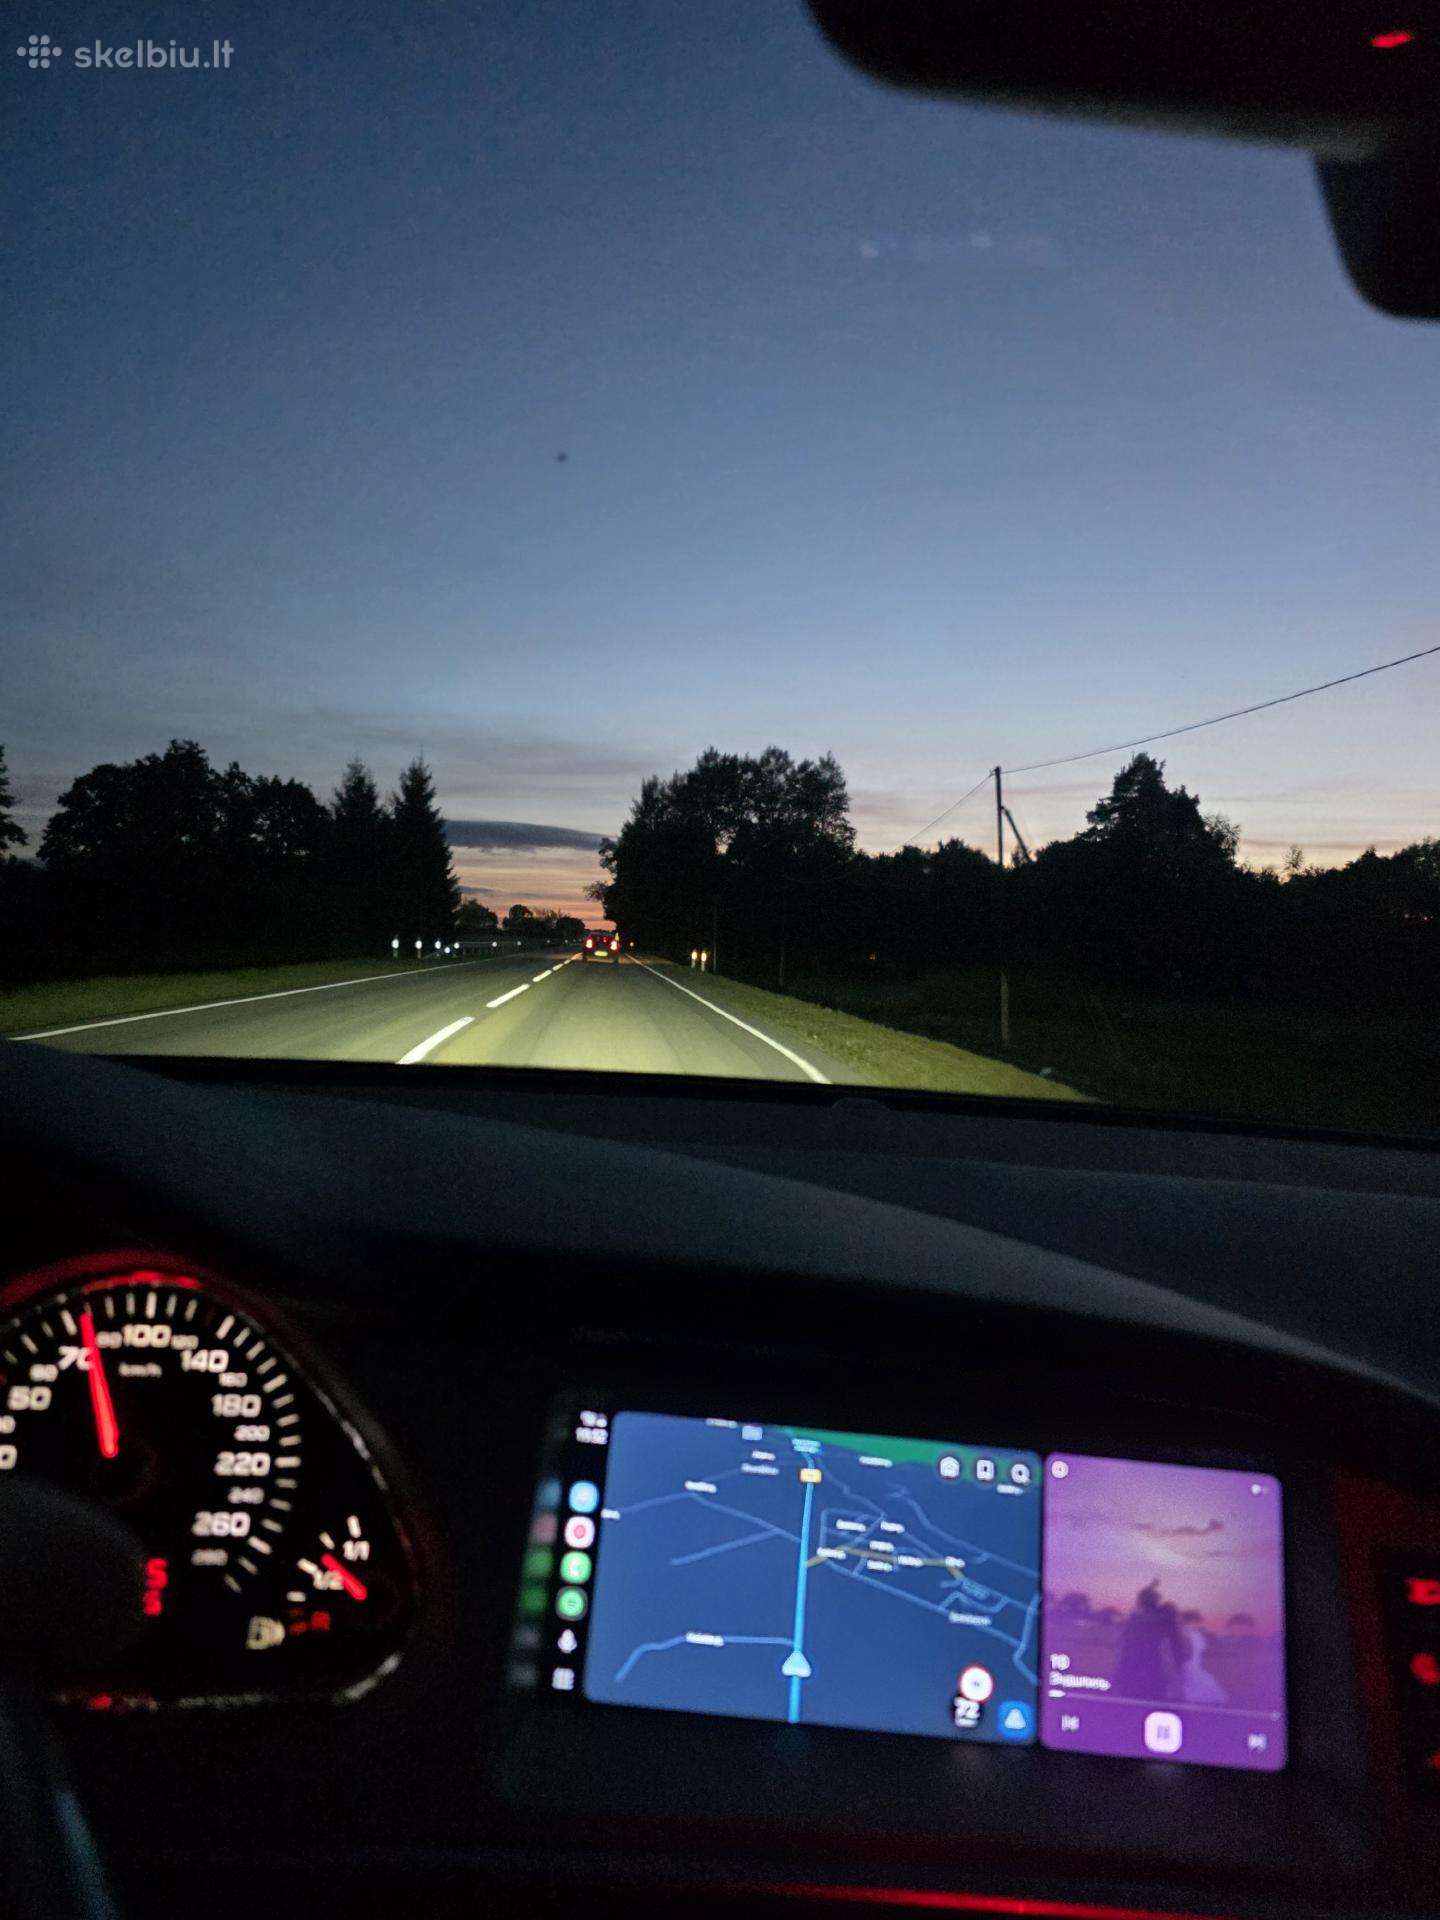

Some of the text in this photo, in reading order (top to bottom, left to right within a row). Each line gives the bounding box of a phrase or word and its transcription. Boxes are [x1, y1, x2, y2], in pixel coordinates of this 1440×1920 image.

[121, 1323, 172, 1348] 100
[181, 1349, 229, 1373] 140
[211, 1393, 262, 1418] 180
[213, 1451, 271, 1476] 220
[191, 1511, 250, 1537] 260
